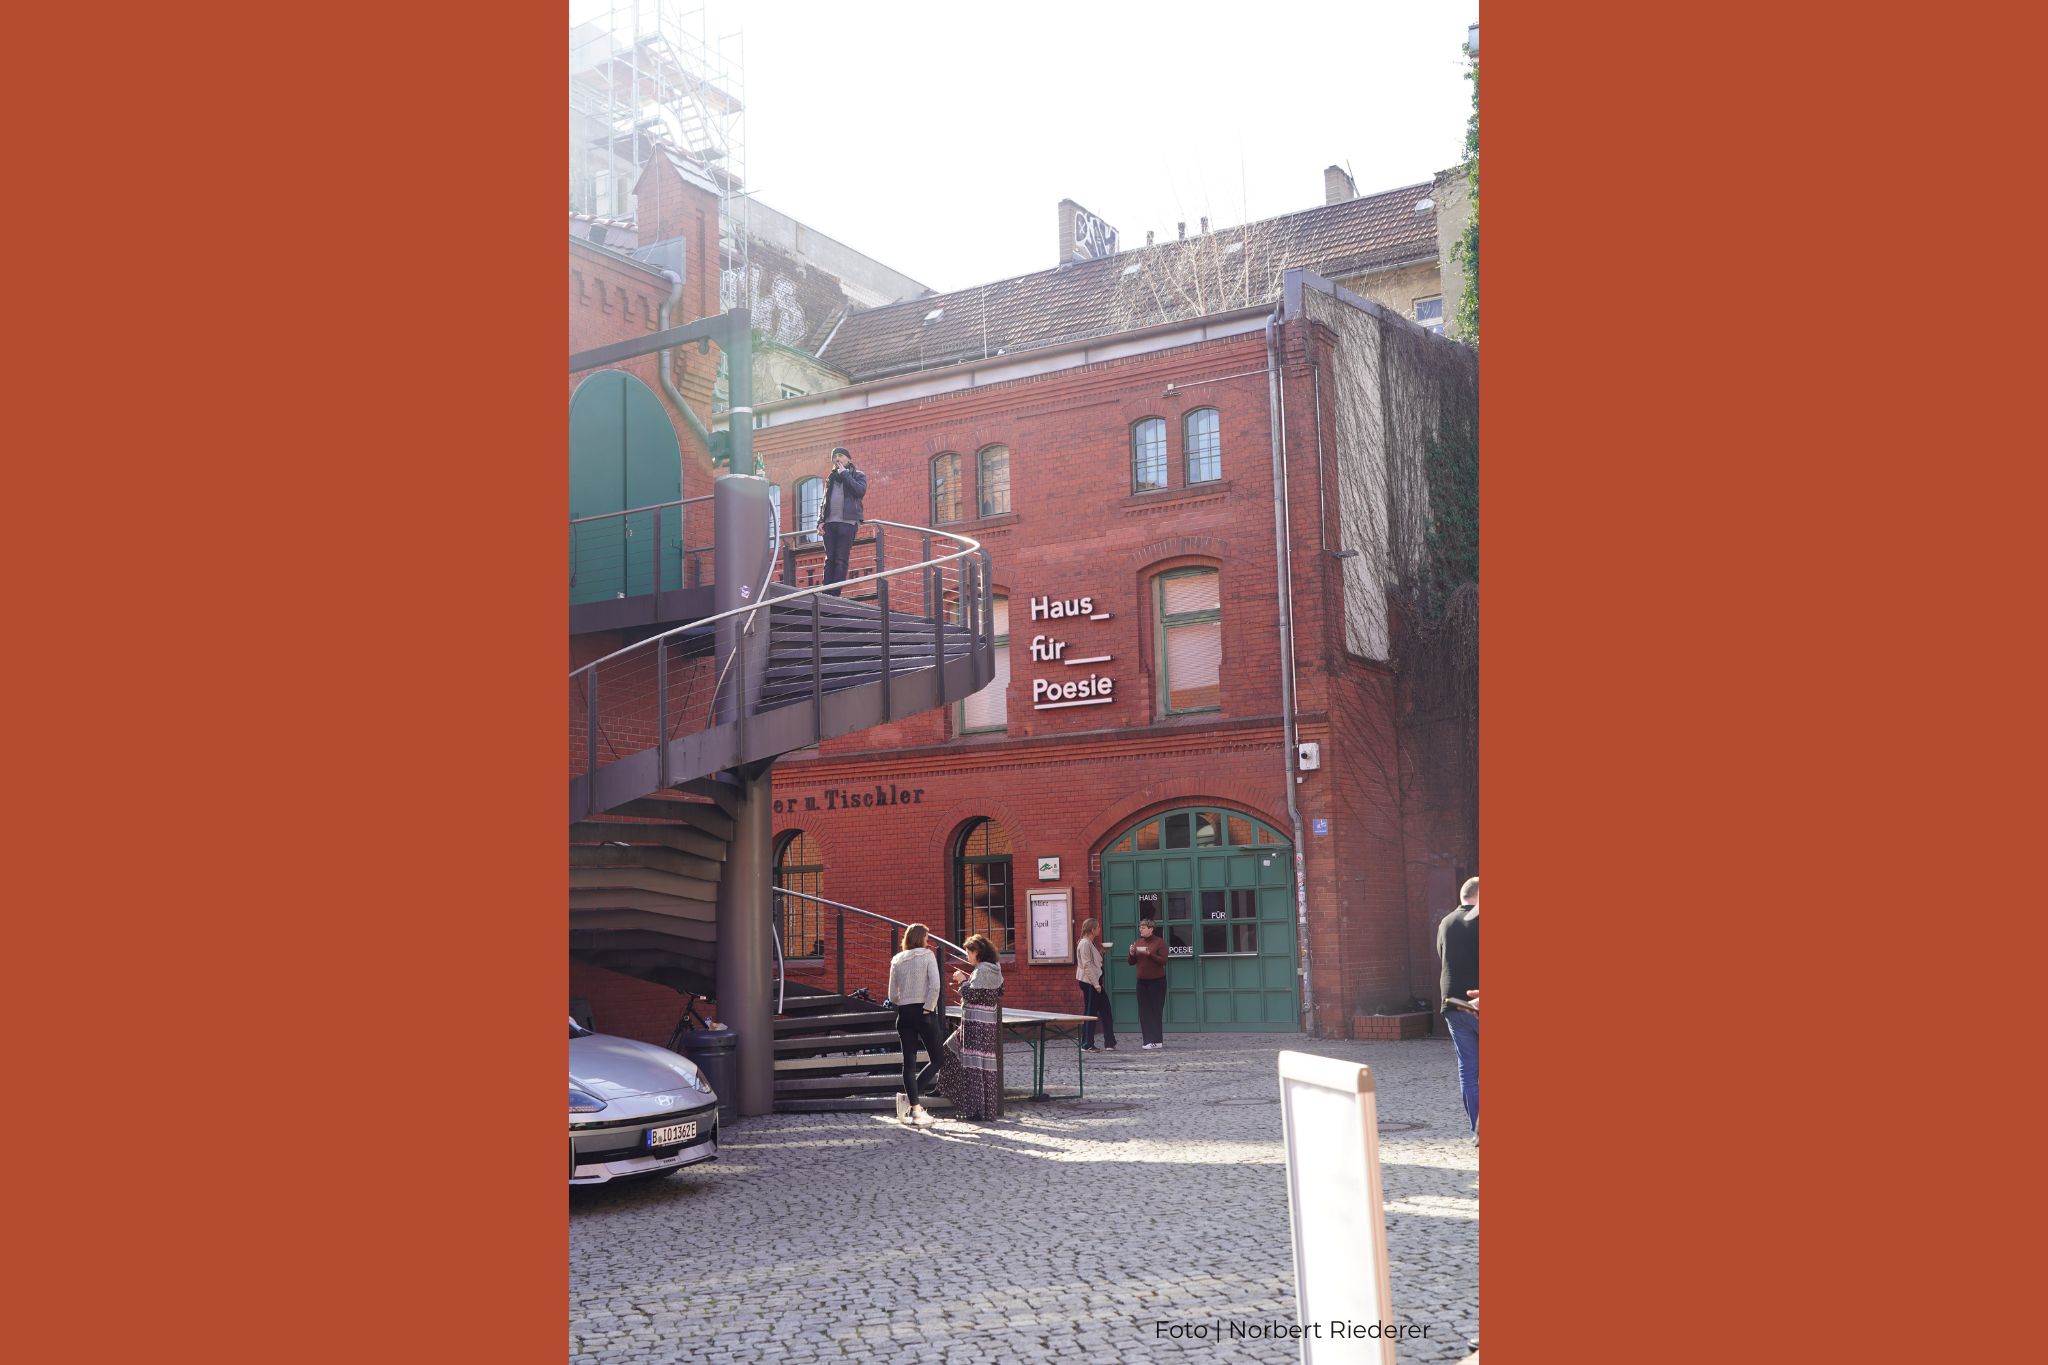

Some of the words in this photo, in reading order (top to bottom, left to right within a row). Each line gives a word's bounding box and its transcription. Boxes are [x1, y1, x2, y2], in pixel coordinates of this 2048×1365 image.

[1033, 674, 1113, 702] Poesie
[824, 784, 924, 809] Tischler
[1211, 911, 1226, 919] FÜR
[1034, 920, 1049, 928] April
[1035, 948, 1047, 956] Mai
